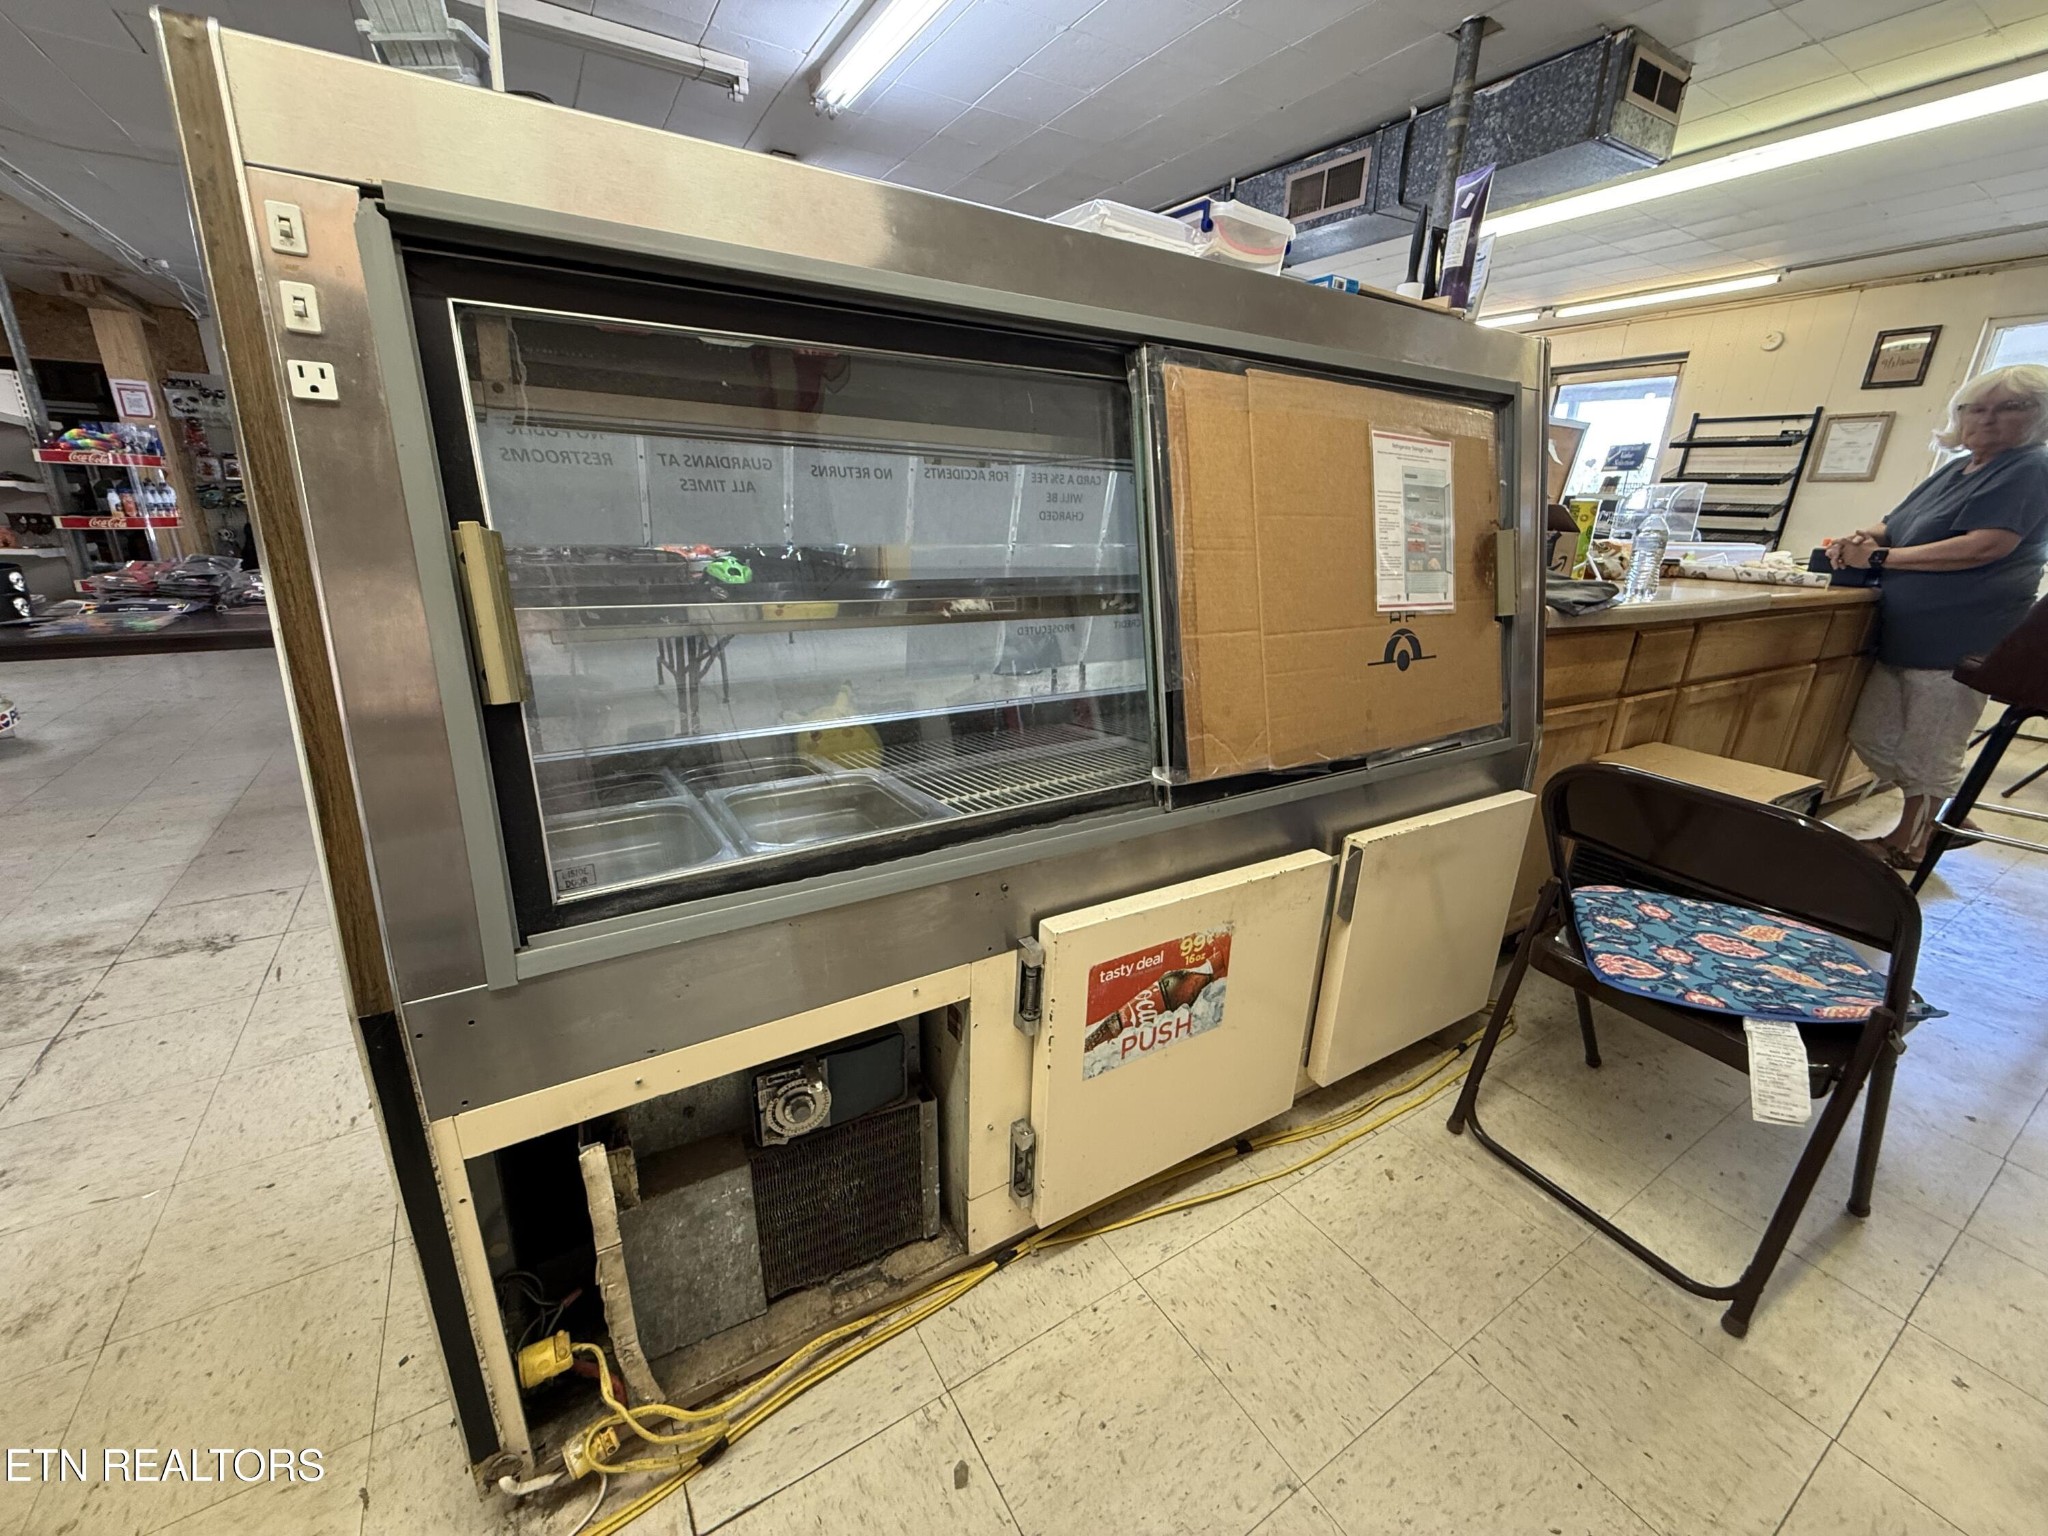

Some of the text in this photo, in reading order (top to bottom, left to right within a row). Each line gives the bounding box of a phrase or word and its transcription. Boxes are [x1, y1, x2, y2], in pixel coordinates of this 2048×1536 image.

[1099, 961, 1134, 984] tasty
[1136, 950, 1164, 971] deal
[1185, 952, 1206, 966] 16oz
[1120, 1012, 1193, 1060] PUSH
